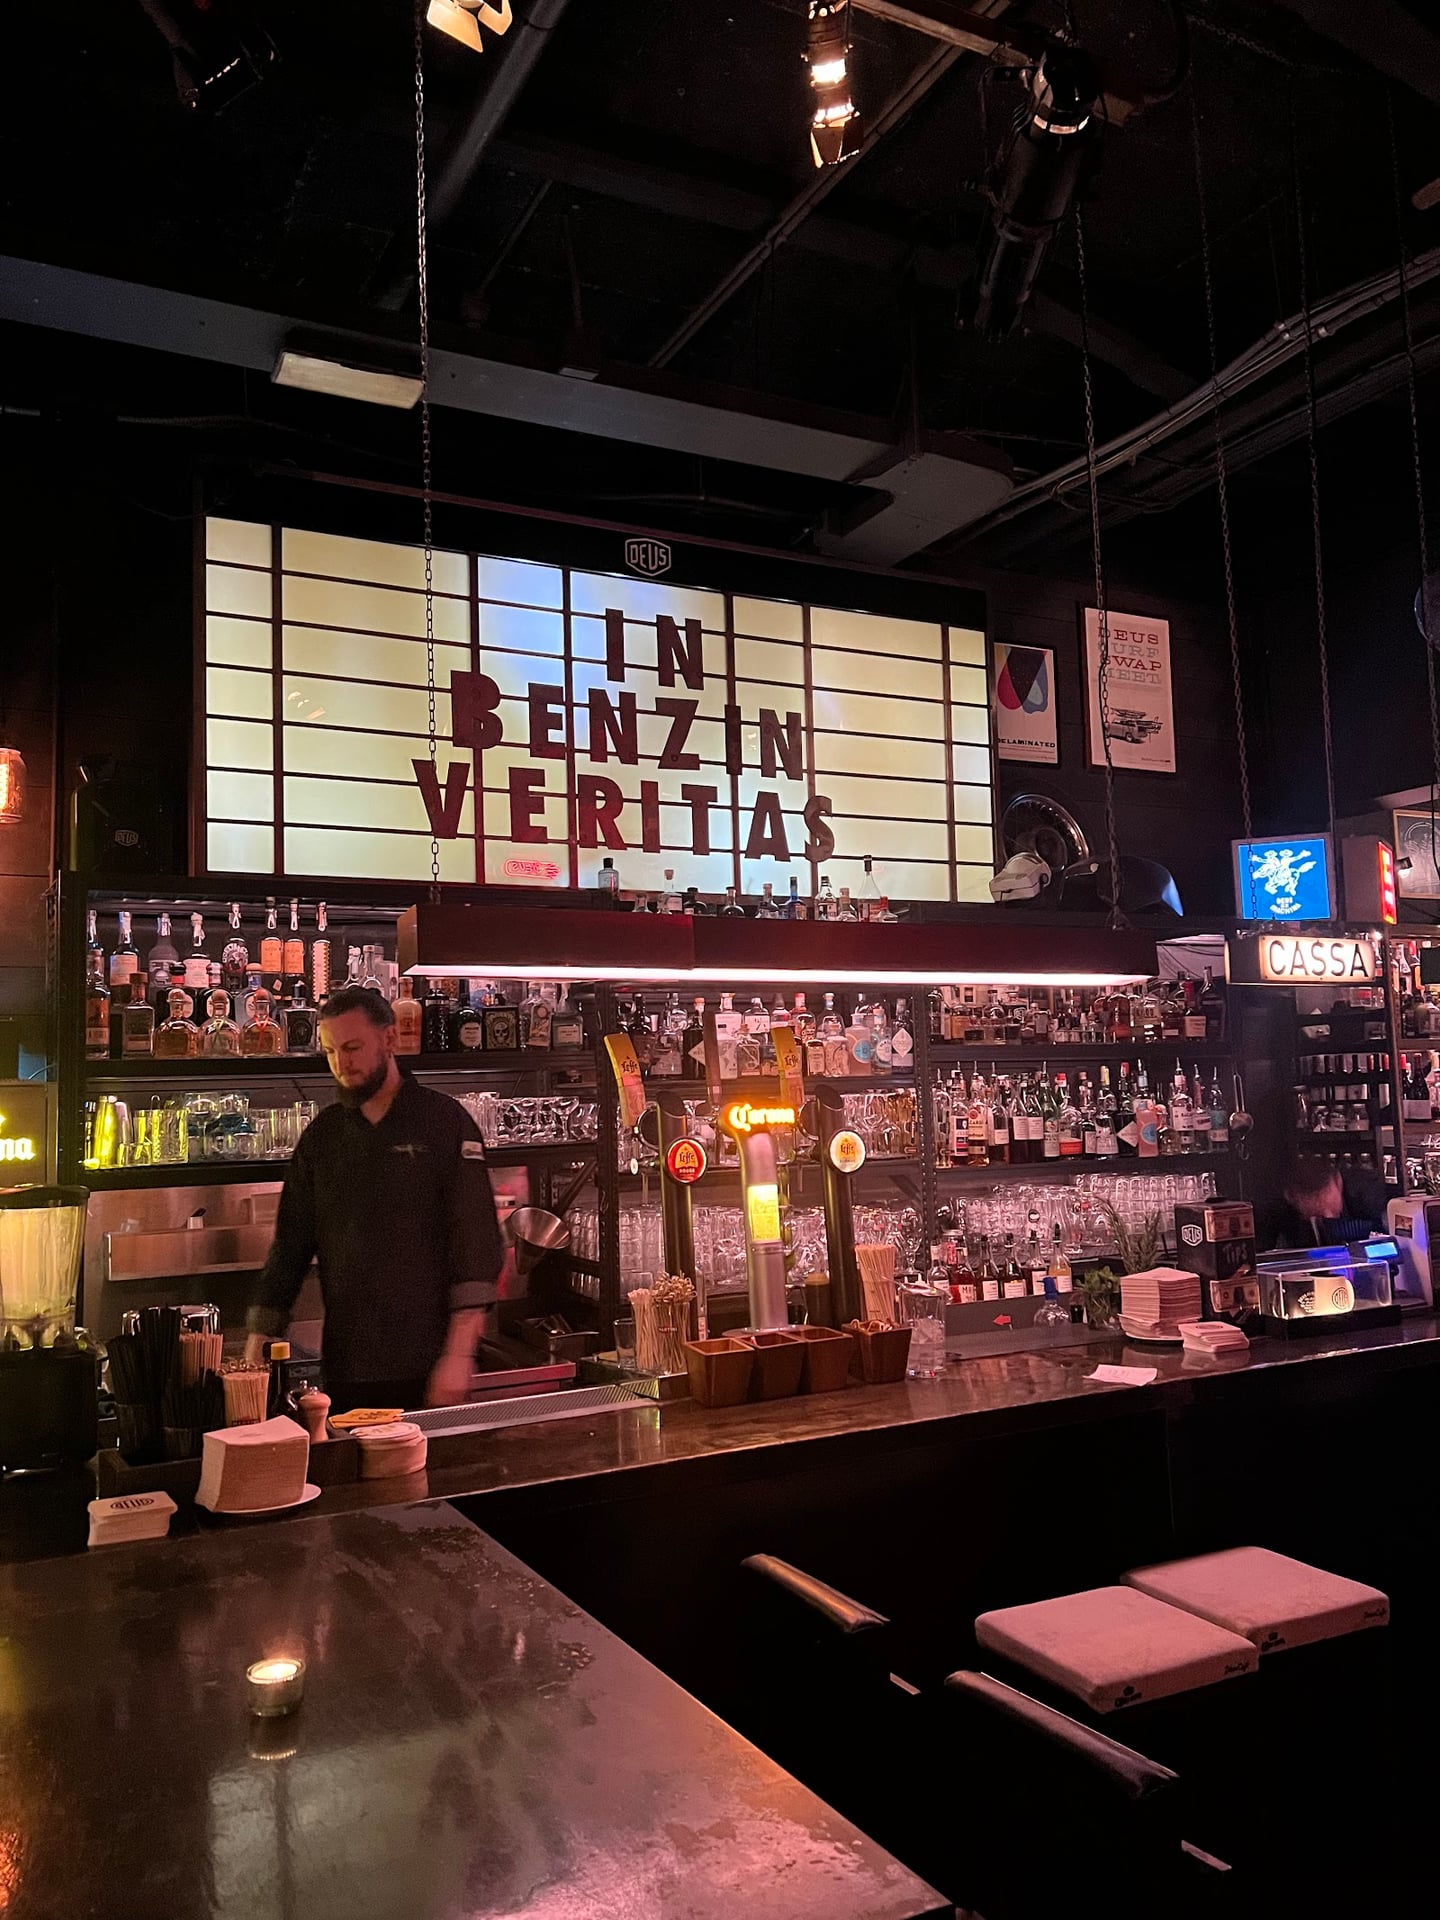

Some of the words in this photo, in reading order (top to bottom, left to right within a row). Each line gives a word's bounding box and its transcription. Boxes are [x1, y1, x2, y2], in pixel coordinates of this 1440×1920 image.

[630, 544, 667, 571] DEUS
[605, 608, 704, 690] IN
[1098, 627, 1159, 645] DEUS
[1098, 641, 1159, 658] URF
[451, 670, 803, 780] BENZIN
[411, 759, 836, 863] VERITAS
[1269, 940, 1369, 977] CASSA
[729, 1103, 796, 1132] Corona
[1183, 1227, 1201, 1243] DEUS
